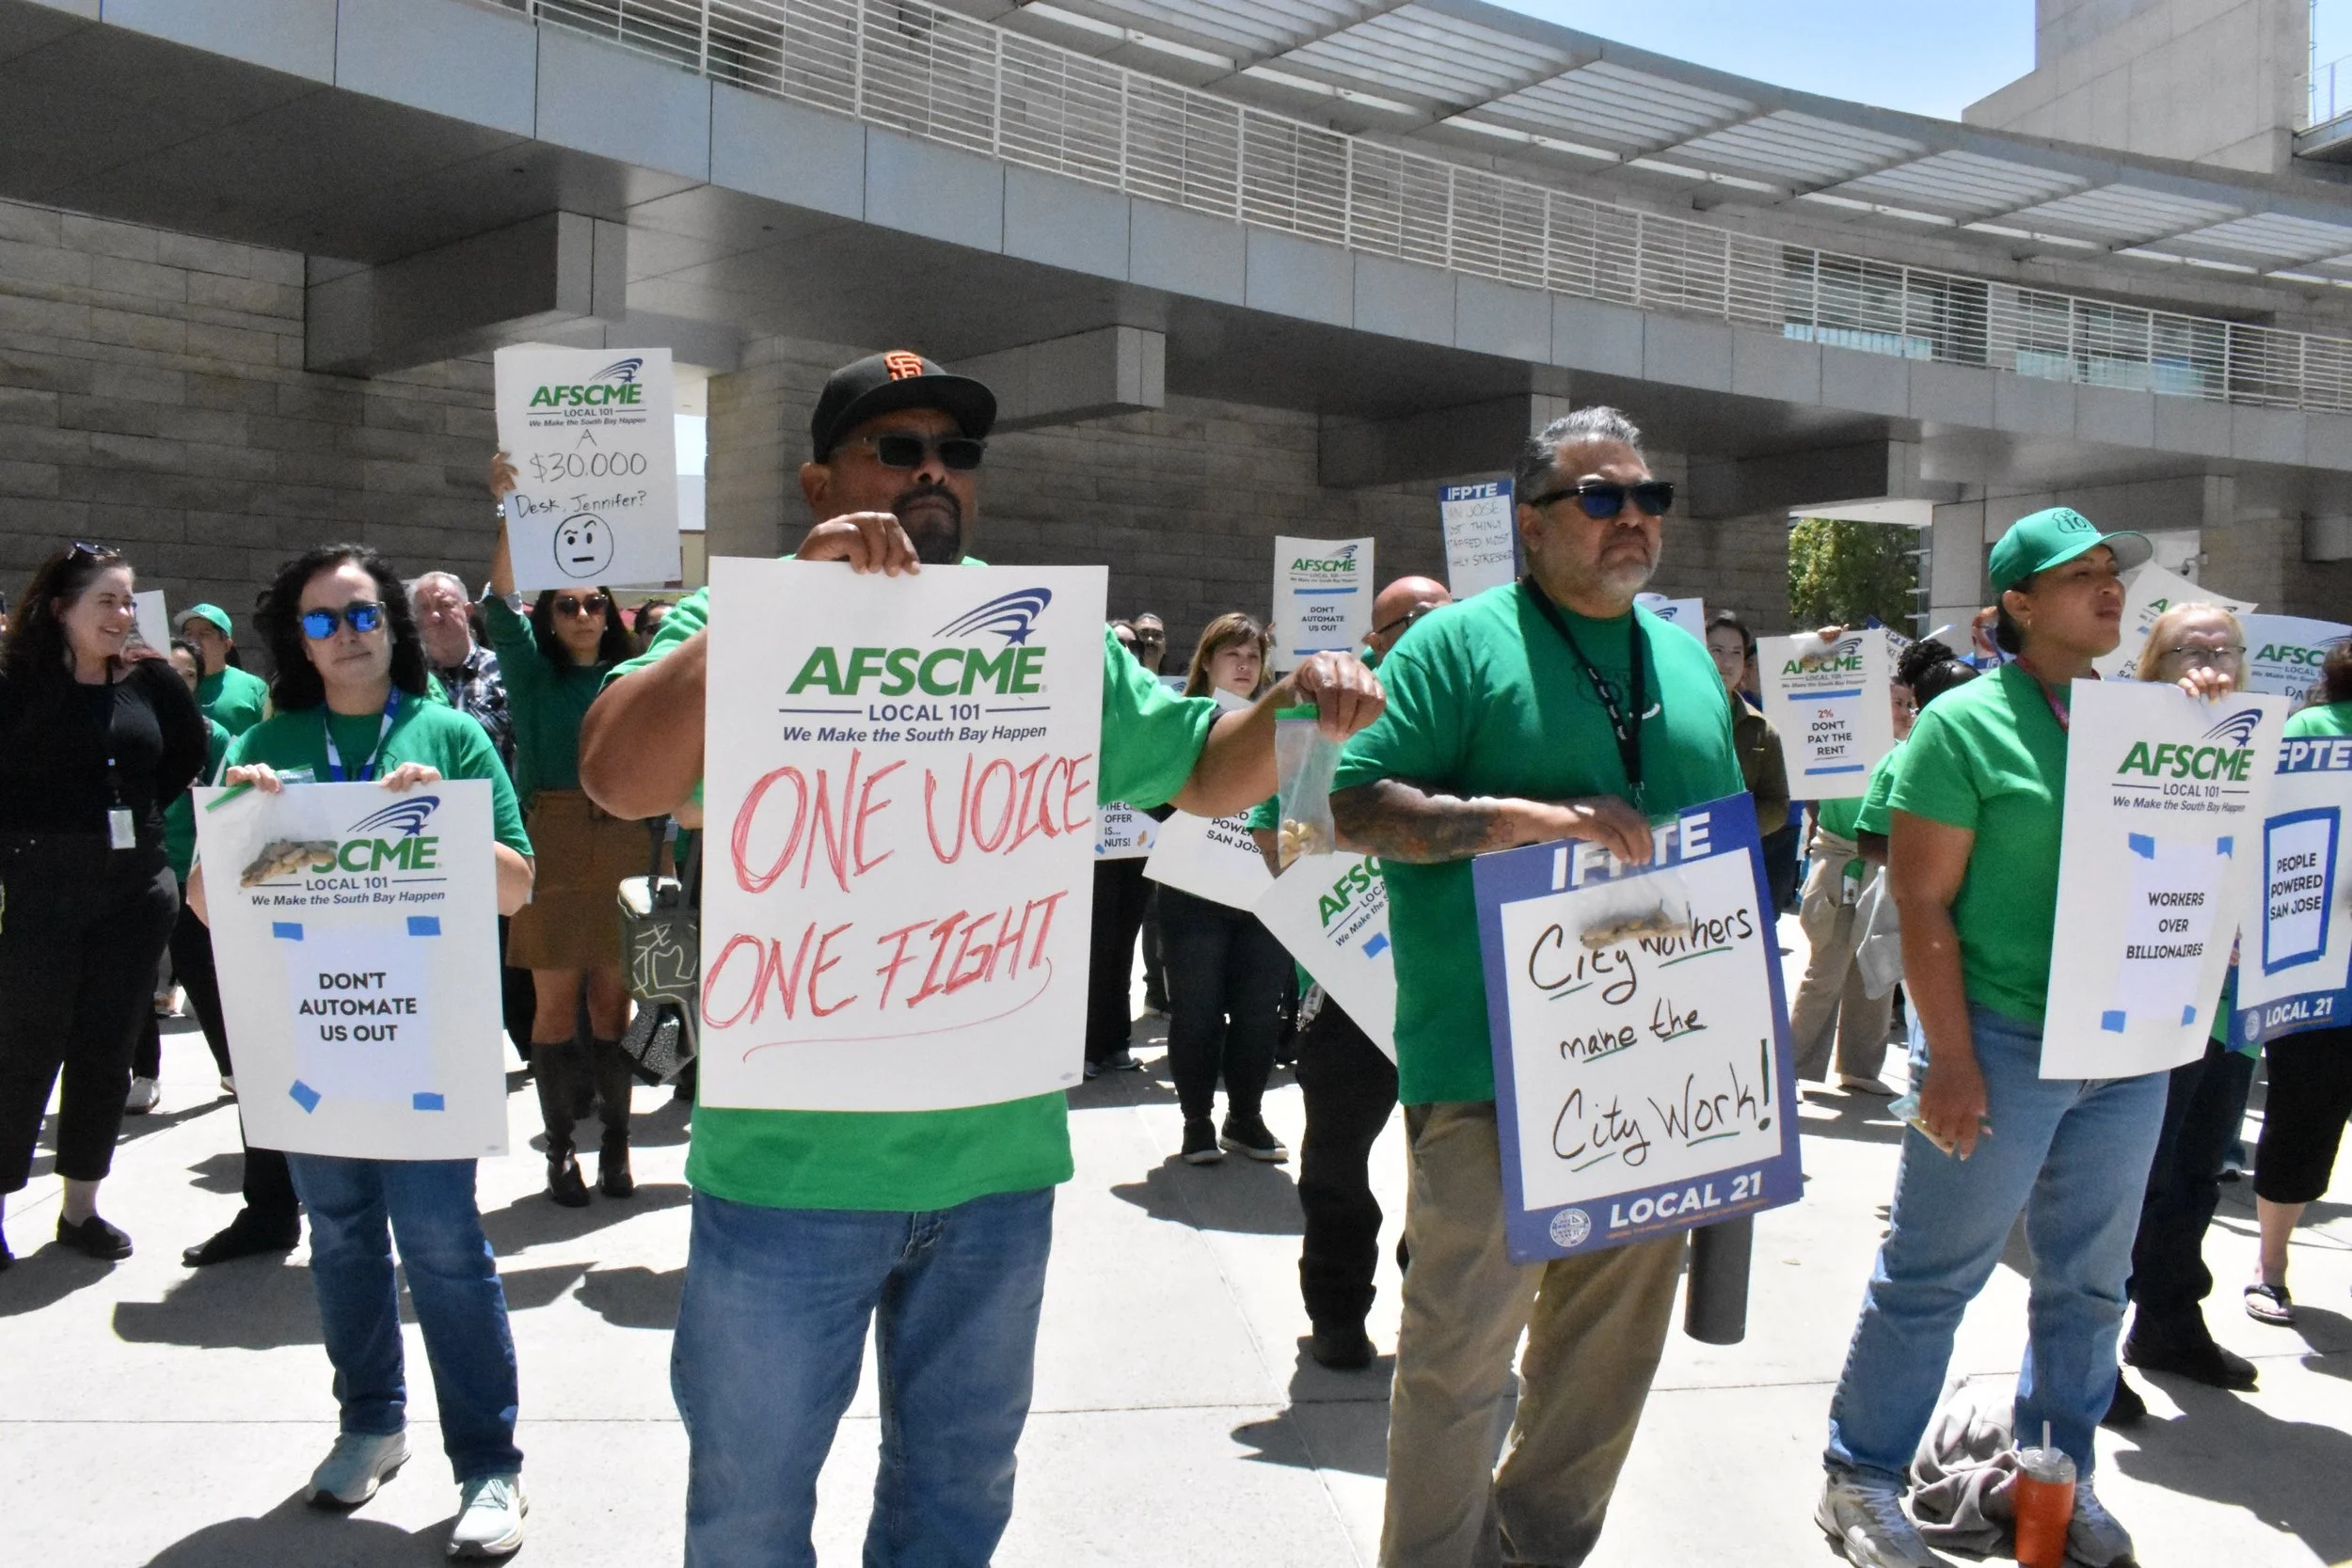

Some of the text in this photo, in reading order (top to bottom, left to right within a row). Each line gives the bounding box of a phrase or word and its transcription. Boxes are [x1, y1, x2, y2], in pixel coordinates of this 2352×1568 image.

[530, 384, 643, 406] AFSCME
[576, 429, 597, 450] A
[1447, 482, 1499, 501] IFPTE
[570, 490, 647, 513] Jennifer?
[1291, 558, 1358, 572] AFSCME
[786, 646, 1046, 697] AFSCME
[2284, 666, 2315, 676] LOCAL
[869, 703, 980, 721] LOCAL 101
[1818, 709, 1835, 719] 2%
[783, 725, 1046, 743] We Make the South Bay Happen
[1812, 721, 1846, 731] DON'T
[1807, 732, 1852, 744] PAY THE
[1818, 745, 1845, 755] RENT
[2116, 741, 2255, 782] AFSCME
[2163, 783, 2219, 798] LOCAL 101
[2113, 796, 2246, 815] We Make the South Bay Happen
[731, 748, 907, 894] ONE
[1104, 814, 1133, 823] OFFER
[1104, 826, 1121, 835] IS...
[1206, 829, 1233, 846] SAN
[1104, 837, 1131, 847] NUTS!
[2277, 852, 2317, 874] PEOPLE
[306, 877, 388, 892] LOCAL 101
[2271, 874, 2324, 899] POWERED
[252, 891, 445, 906] We Make the South Bay Happen
[2148, 892, 2204, 907] WORKERS
[2270, 895, 2322, 921] SAN JOSE
[1335, 900, 1385, 947] We Make the
[2158, 918, 2189, 933] OVER
[702, 890, 1069, 1029] ONE FIGHT
[2126, 942, 2203, 959] BILLIONAIRES
[319, 972, 387, 990] DON'T
[299, 998, 417, 1015] AUTOMATE
[2265, 1000, 2310, 1028] LOCAL
[2313, 996, 2333, 1017] 21
[1649, 997, 1701, 1038] the
[321, 1024, 398, 1041] US OUT
[1553, 1088, 1650, 1166] City
[1610, 1183, 1721, 1228] LOCAL
[1729, 1171, 1762, 1202] 21
